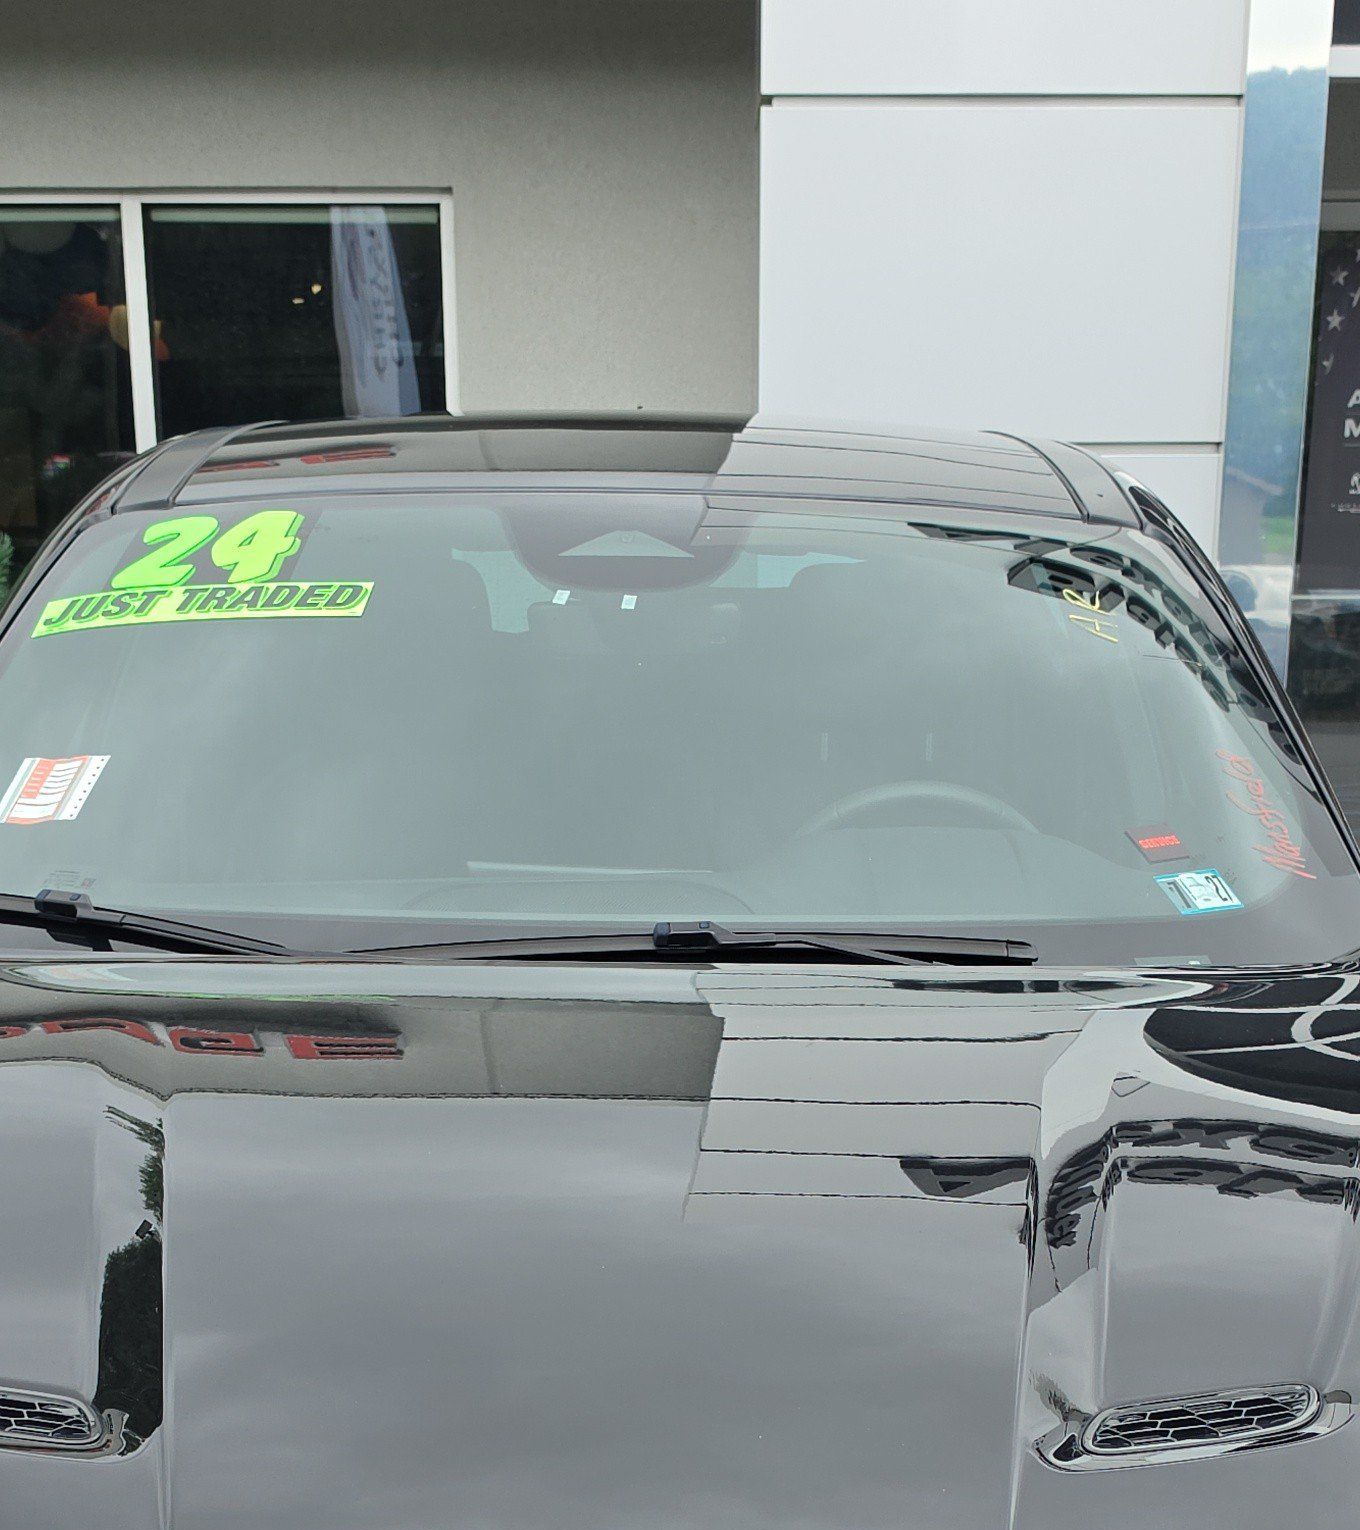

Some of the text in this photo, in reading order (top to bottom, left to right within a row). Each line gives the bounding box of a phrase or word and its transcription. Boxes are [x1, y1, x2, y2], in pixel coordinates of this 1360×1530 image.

[111, 510, 305, 590] 24
[43, 584, 369, 628] JUST TRADED
[1204, 874, 1234, 903] 27
